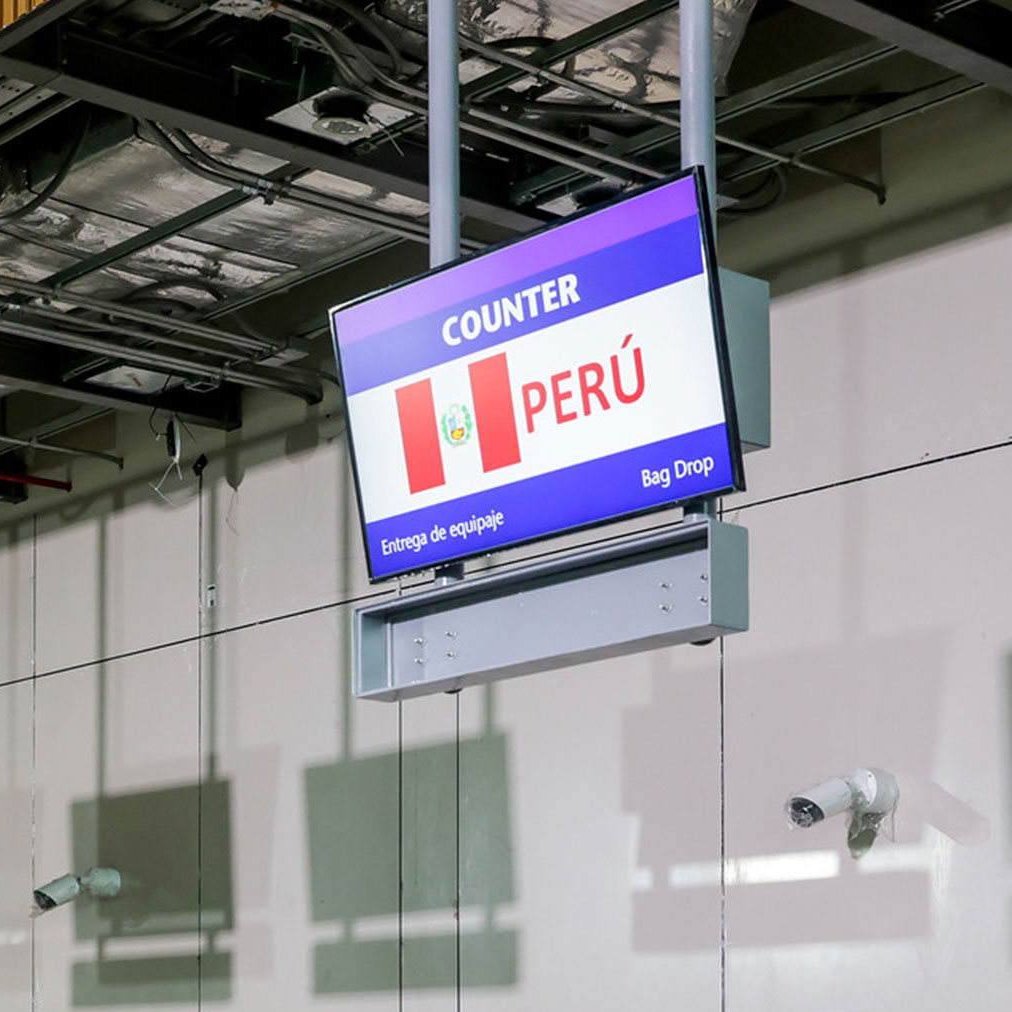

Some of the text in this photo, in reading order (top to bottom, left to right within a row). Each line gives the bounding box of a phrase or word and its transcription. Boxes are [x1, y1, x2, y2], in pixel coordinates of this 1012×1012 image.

[442, 273, 581, 346] COUNTER
[521, 333, 646, 434] PERÚ
[641, 456, 714, 488] Bag Drop
[381, 509, 504, 555] Entrega de equipaje
